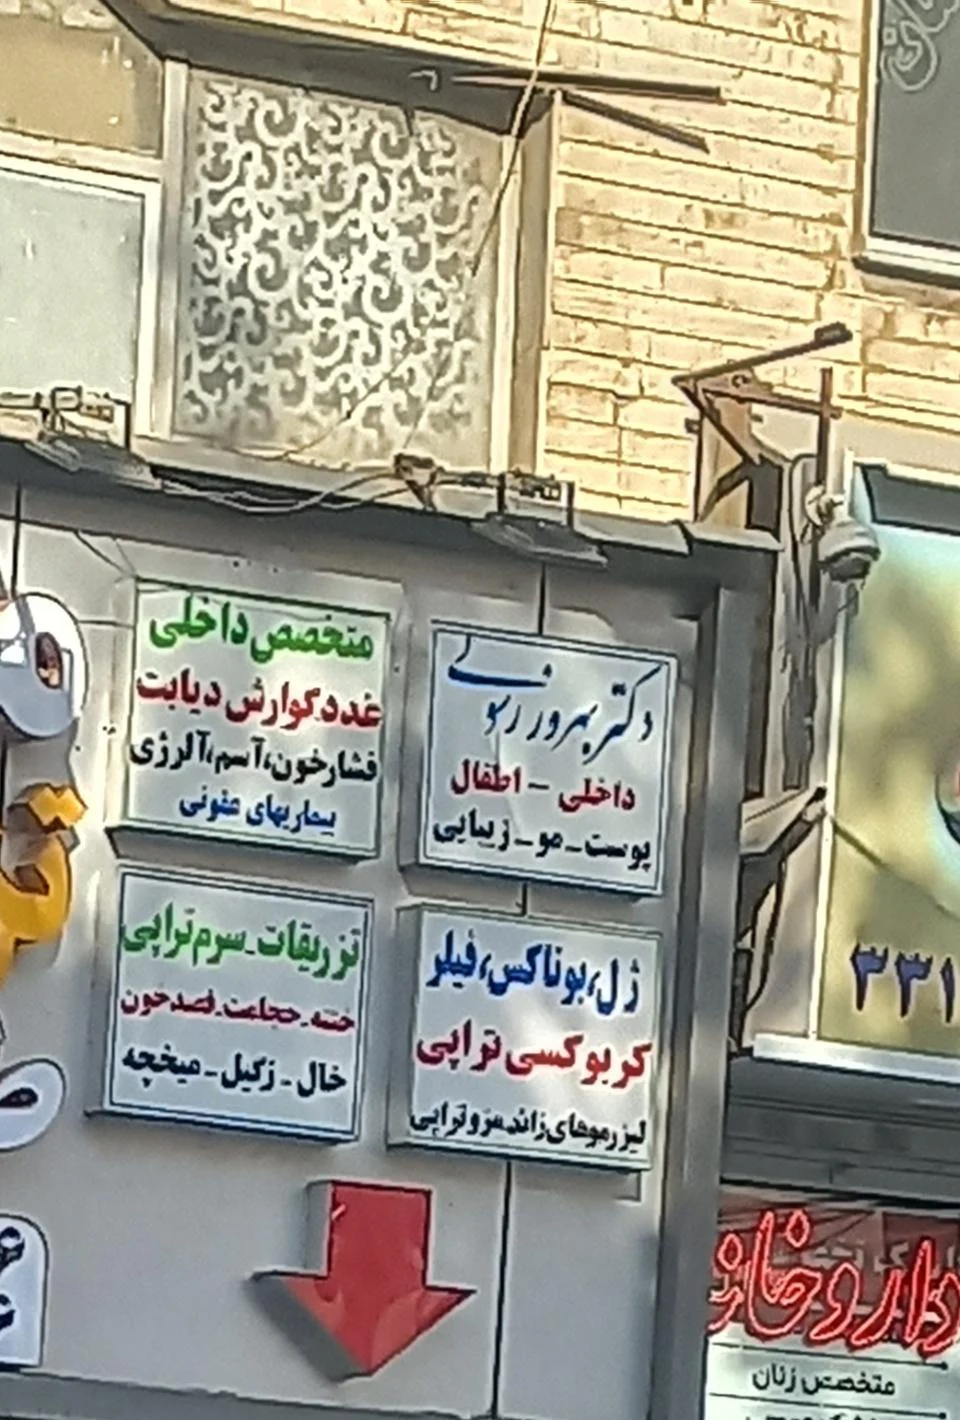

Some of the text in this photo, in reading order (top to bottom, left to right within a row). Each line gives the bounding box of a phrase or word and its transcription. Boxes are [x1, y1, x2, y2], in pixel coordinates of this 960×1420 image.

[150, 594, 374, 665] متخصص داخلی
[136, 668, 222, 715] دیابت
[320, 691, 384, 728] غدد
[583, 662, 663, 766] دکتر
[451, 758, 522, 795] اطفال
[558, 778, 637, 813] داخلی
[179, 784, 337, 837] بیماریهای عفونی
[433, 808, 510, 852] زیبایی
[535, 832, 564, 858] مو
[585, 833, 651, 873] پوست
[258, 919, 361, 981] تزریقات
[426, 928, 477, 989] فیلر
[122, 1044, 201, 1088] میخچه
[221, 1052, 275, 1092] زگیل
[416, 1018, 653, 1089] کربوکسی تراپی
[296, 1060, 347, 1098] خال
[753, 1363, 896, 1396] متخصص زنان
